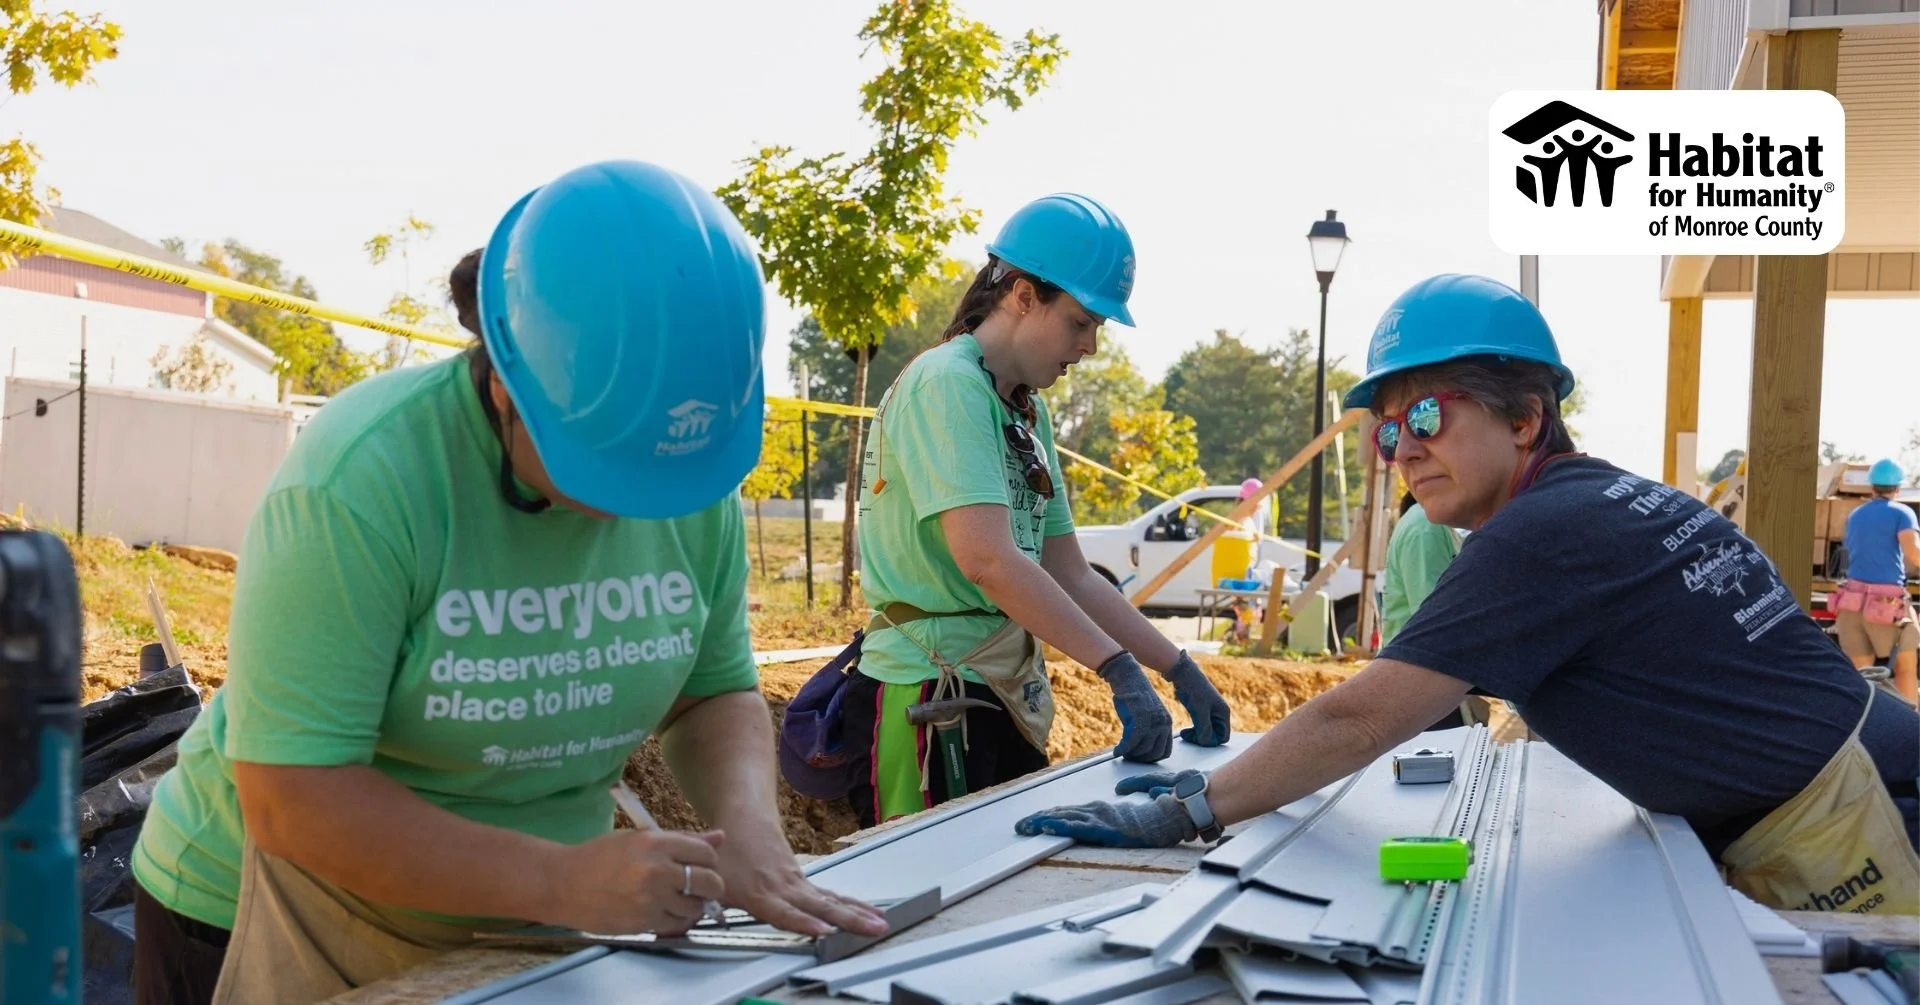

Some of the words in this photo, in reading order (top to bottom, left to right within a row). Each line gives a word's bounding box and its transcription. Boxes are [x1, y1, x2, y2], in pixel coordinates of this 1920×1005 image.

[436, 570, 693, 640] everyone
[430, 647, 581, 683] deserves
[585, 648, 602, 670] a
[606, 627, 694, 667] decent
[424, 690, 528, 722] place
[533, 688, 562, 717] to
[566, 680, 613, 711] live
[509, 744, 563, 762] Habitat
[566, 740, 587, 756] for
[1809, 857, 1883, 911] hand
